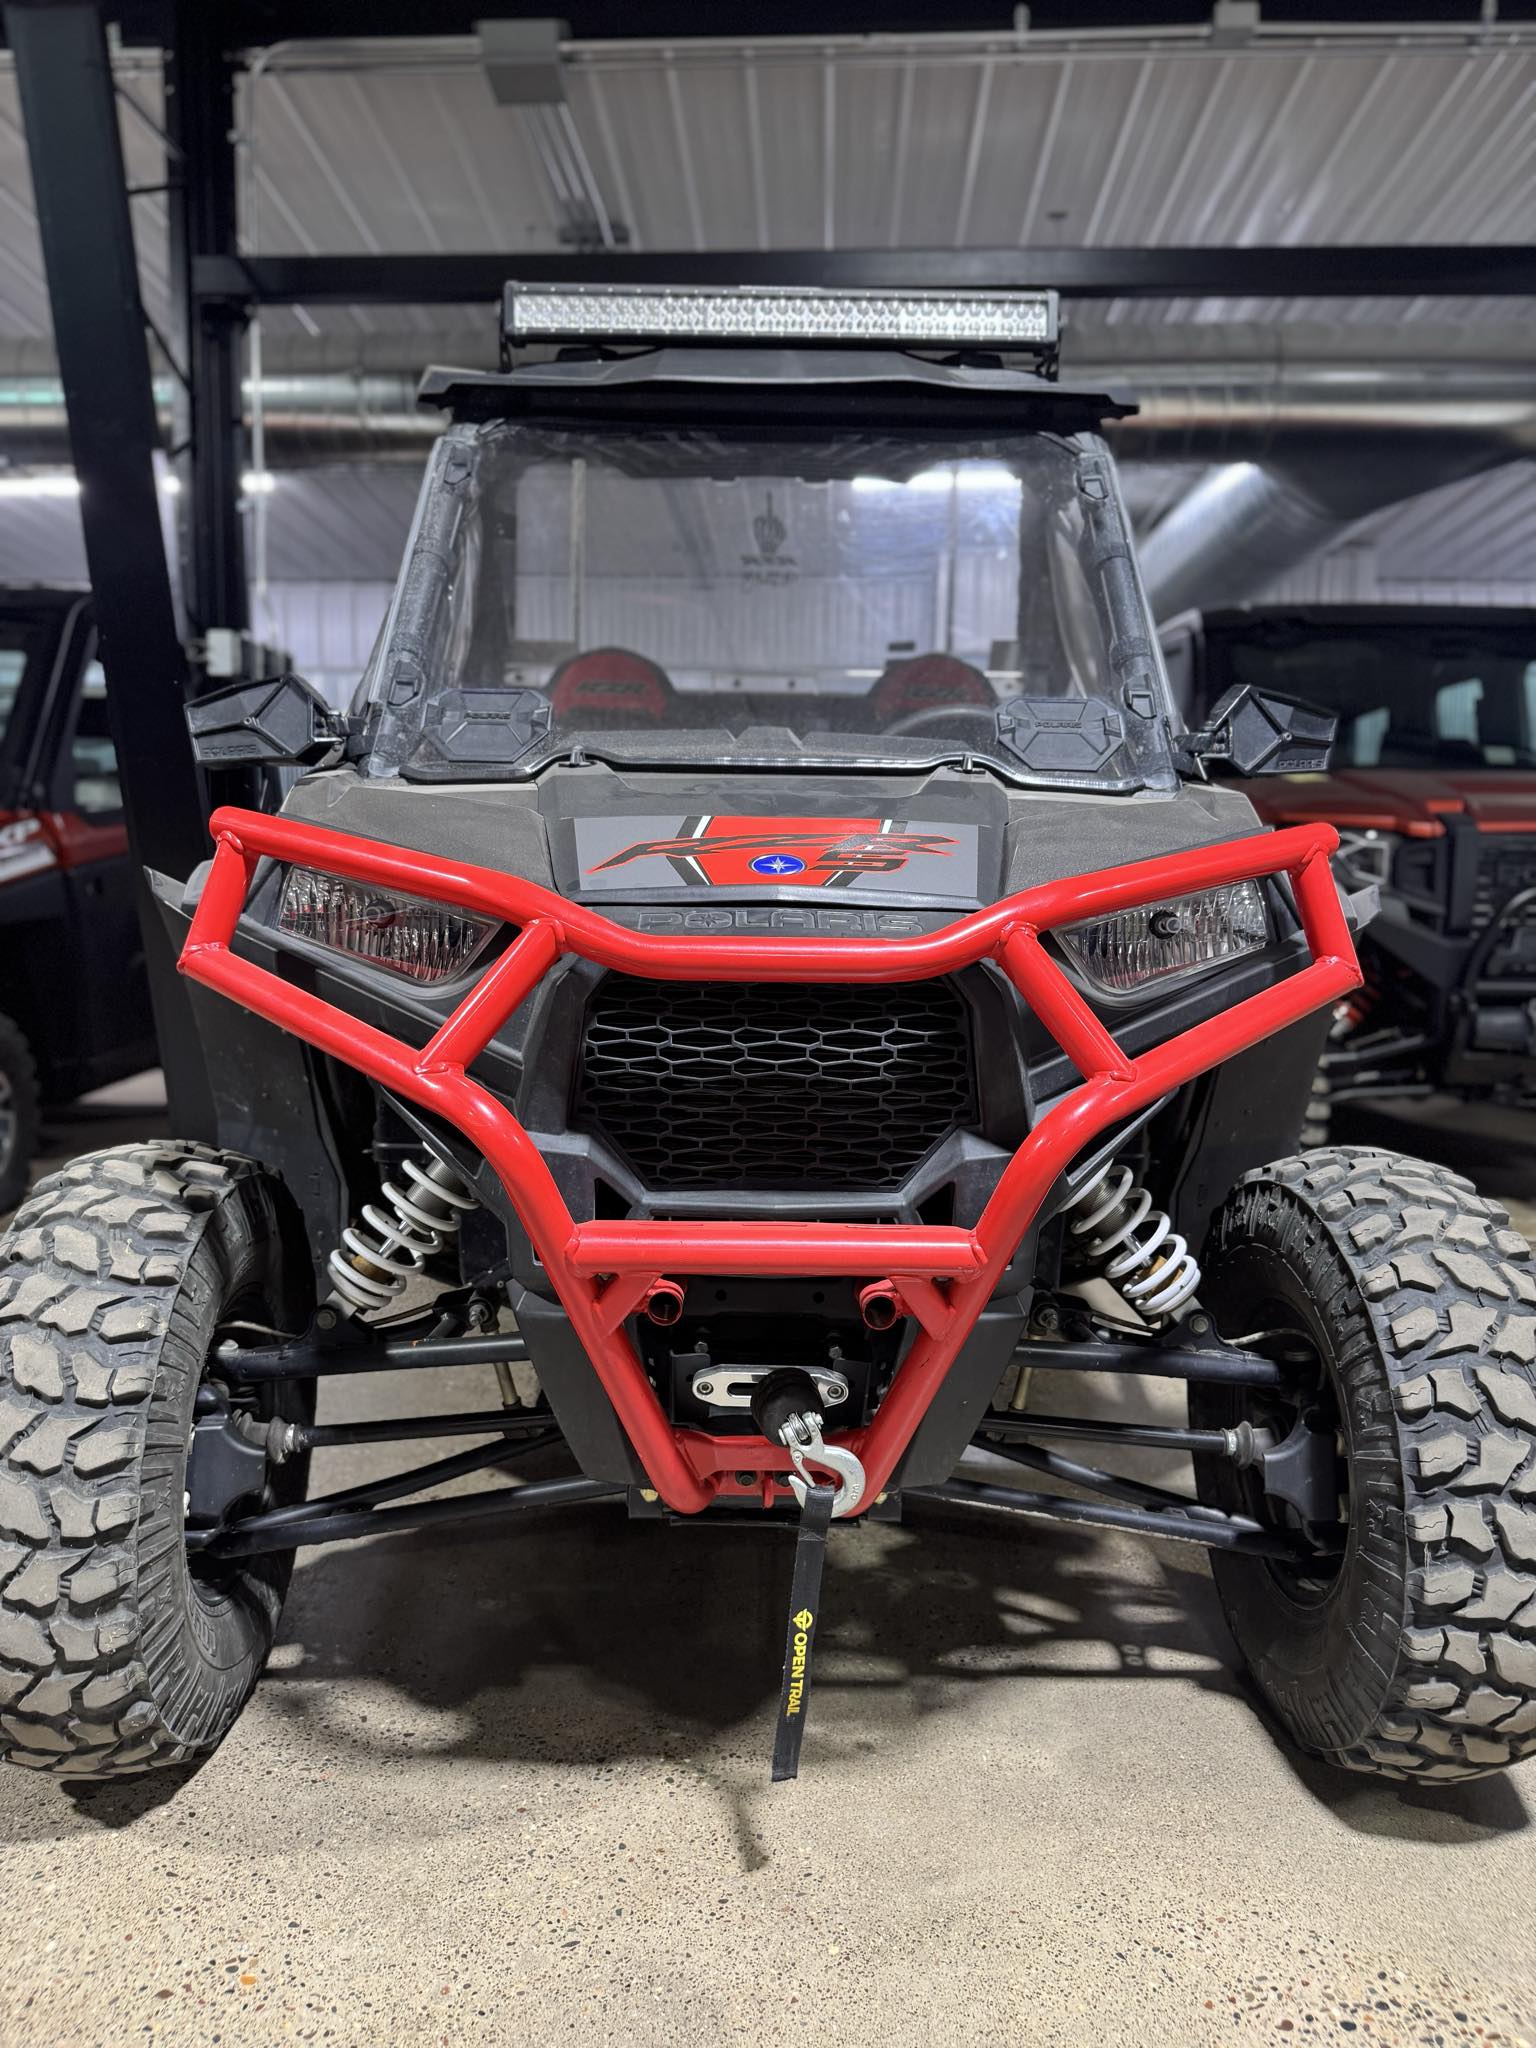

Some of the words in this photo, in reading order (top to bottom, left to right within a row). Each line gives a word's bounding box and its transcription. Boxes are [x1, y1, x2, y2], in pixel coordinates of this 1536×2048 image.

[1279, 759, 1324, 769] POLARIS
[637, 909, 923, 934] POLARIS
[791, 1632, 808, 1678] OPEN
[786, 1679, 804, 1717] TRAIL
